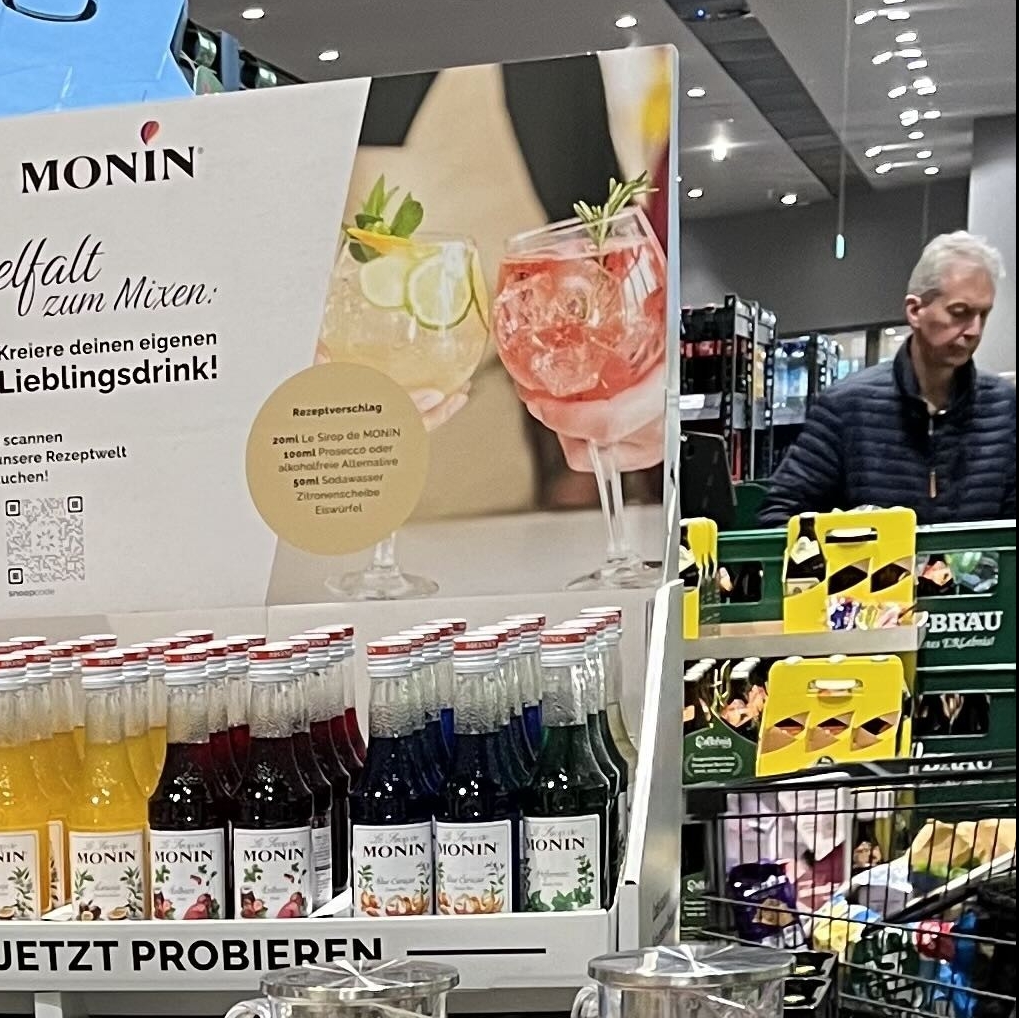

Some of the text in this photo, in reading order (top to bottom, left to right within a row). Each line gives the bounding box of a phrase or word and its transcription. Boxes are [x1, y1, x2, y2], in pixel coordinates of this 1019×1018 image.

[21, 146, 196, 194] MONIN
[43, 275, 218, 318] zum Mixen:
[69, 338, 133, 356] deinen
[139, 331, 217, 352] eigenen
[292, 403, 382, 418] Rezeptvorschlag
[3, 433, 63, 447] scannen
[272, 434, 299, 445] 20ml
[302, 434, 314, 443] Le
[317, 432, 344, 444] Sirop
[346, 431, 360, 440] de
[46, 446, 128, 465] Rezeptwelt
[283, 444, 394, 459] 100ml Prosecco oder
[278, 456, 399, 473] alkoholfreie Alternative
[293, 473, 384, 488] 50ml Sodawasser
[296, 488, 380, 501] Zitronenscheibe
[315, 503, 363, 515] Eiswürfel
[78, 850, 136, 864] MONIN
[155, 850, 213, 863] MONIN
[244, 848, 305, 863] MONIN
[363, 843, 425, 858] MONIN
[132, 937, 382, 971] PROBIEREN
